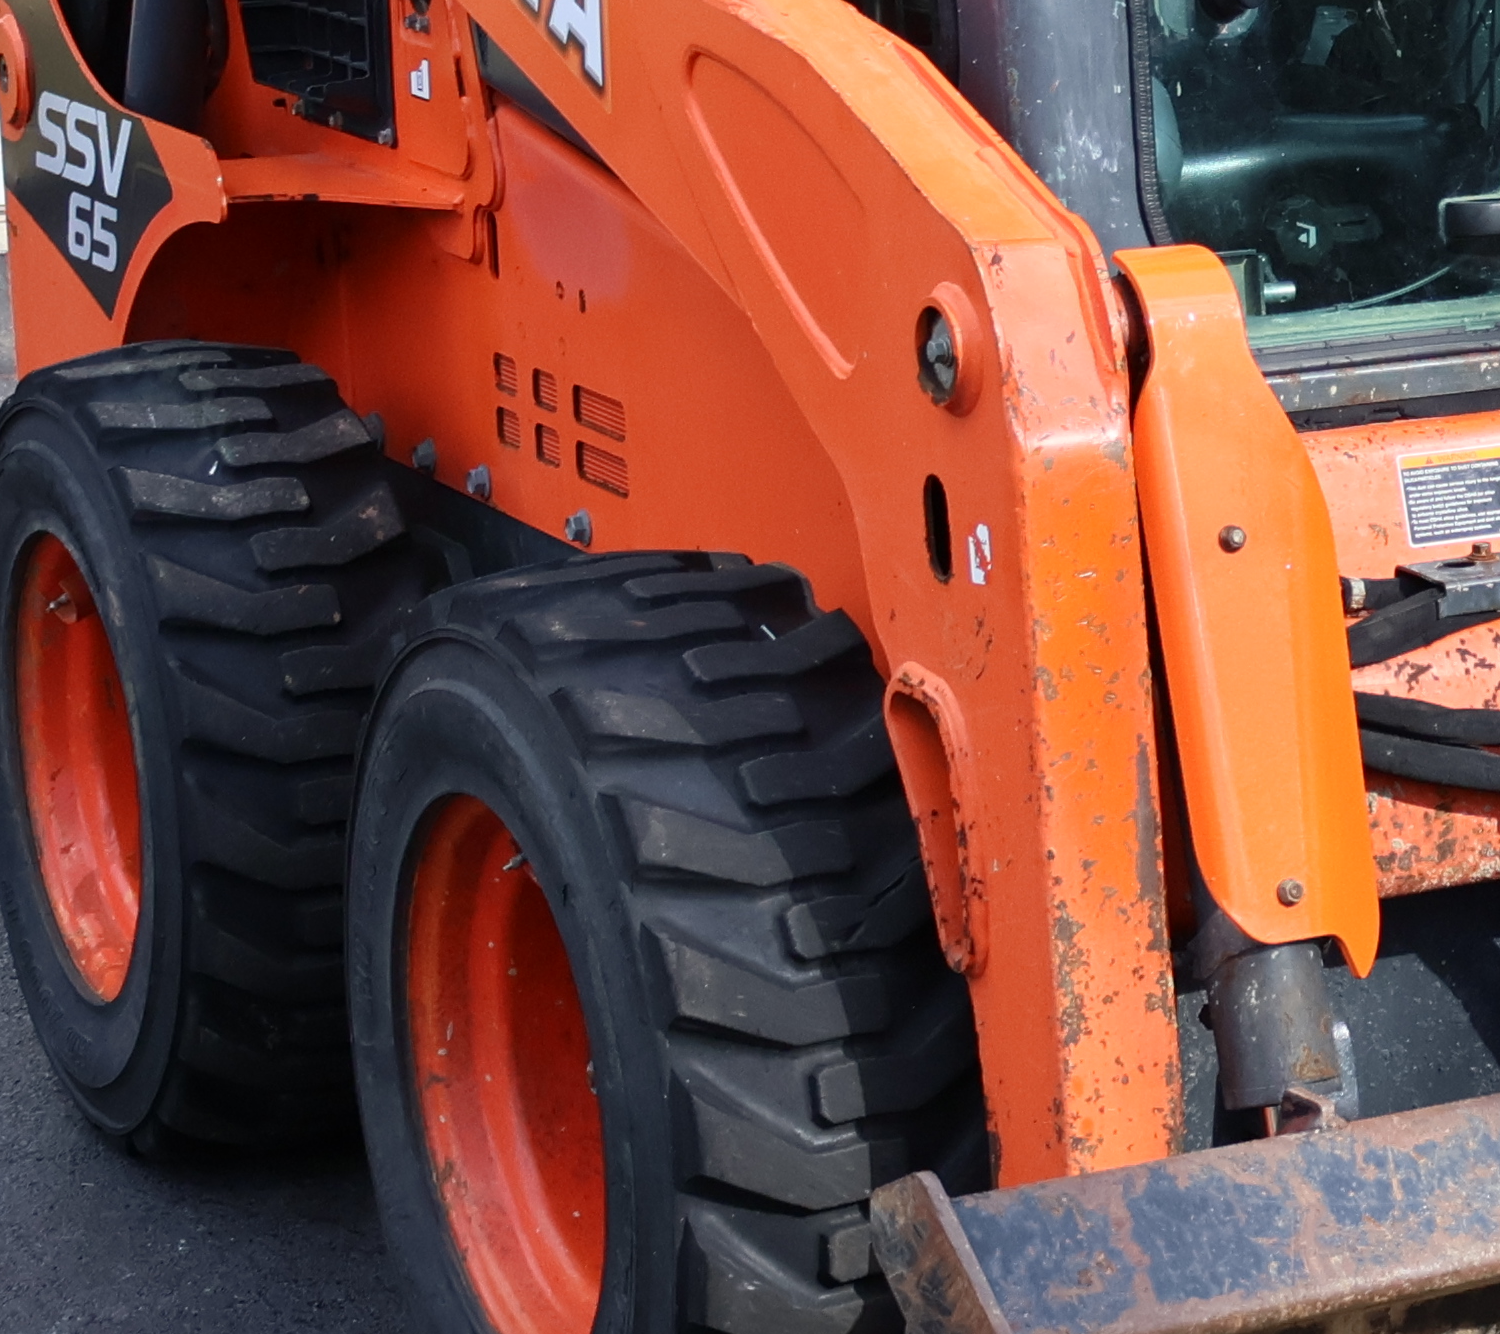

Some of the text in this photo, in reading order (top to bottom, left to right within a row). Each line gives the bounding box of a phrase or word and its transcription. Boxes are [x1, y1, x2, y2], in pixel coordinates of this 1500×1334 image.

[35, 90, 132, 198] SSV
[67, 191, 118, 273] 65
[1437, 451, 1477, 463] WARNING
